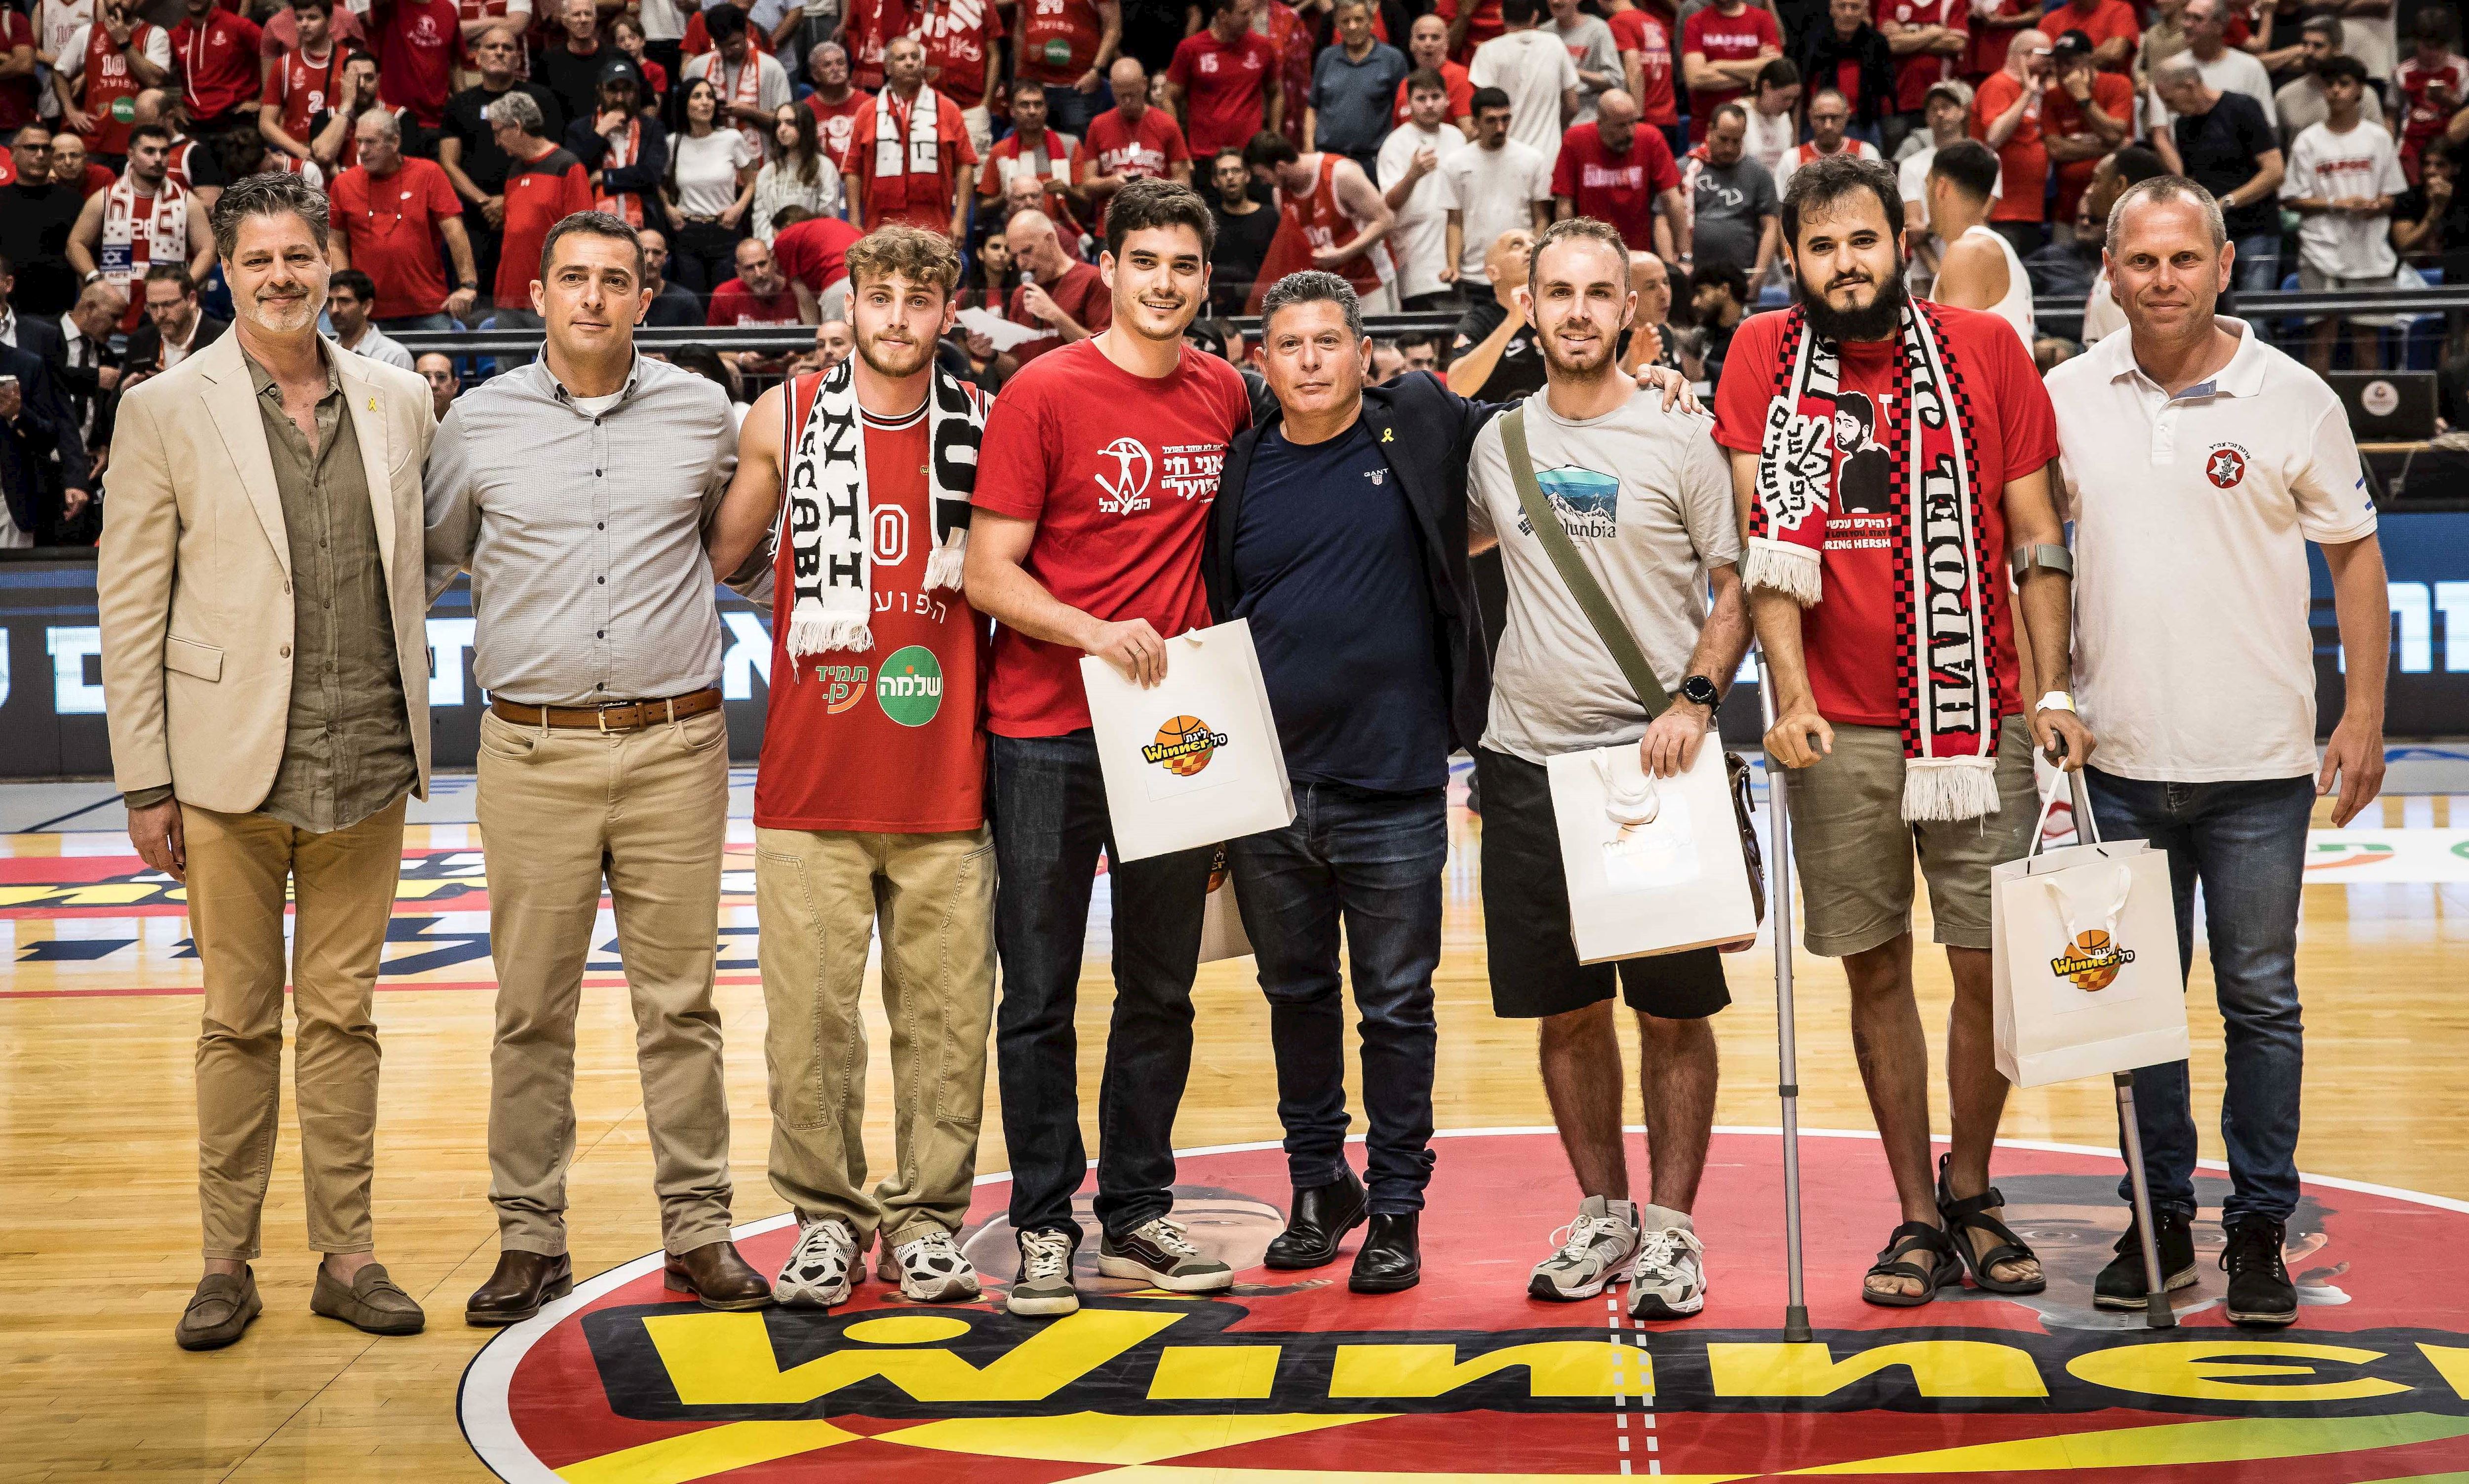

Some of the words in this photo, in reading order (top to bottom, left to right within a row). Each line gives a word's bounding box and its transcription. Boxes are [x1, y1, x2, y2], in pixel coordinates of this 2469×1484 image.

[1163, 456, 1190, 475] חי
[1195, 455, 1223, 474] אני
[1364, 467, 1389, 477] GANT
[1853, 518, 1885, 529] הירש
[1822, 540, 1852, 550] RING
[1854, 538, 1892, 549] HERSH
[1921, 453, 1980, 735] HAPOEL
[873, 590, 946, 624] הפוע
[815, 665, 869, 683] תמיד
[879, 673, 942, 697] שלמה
[1185, 728, 1208, 743] ליגת
[1211, 733, 1227, 745] סל
[1143, 738, 1209, 761] Winner
[2052, 954, 2117, 975] Winner
[2118, 949, 2134, 962] סל
